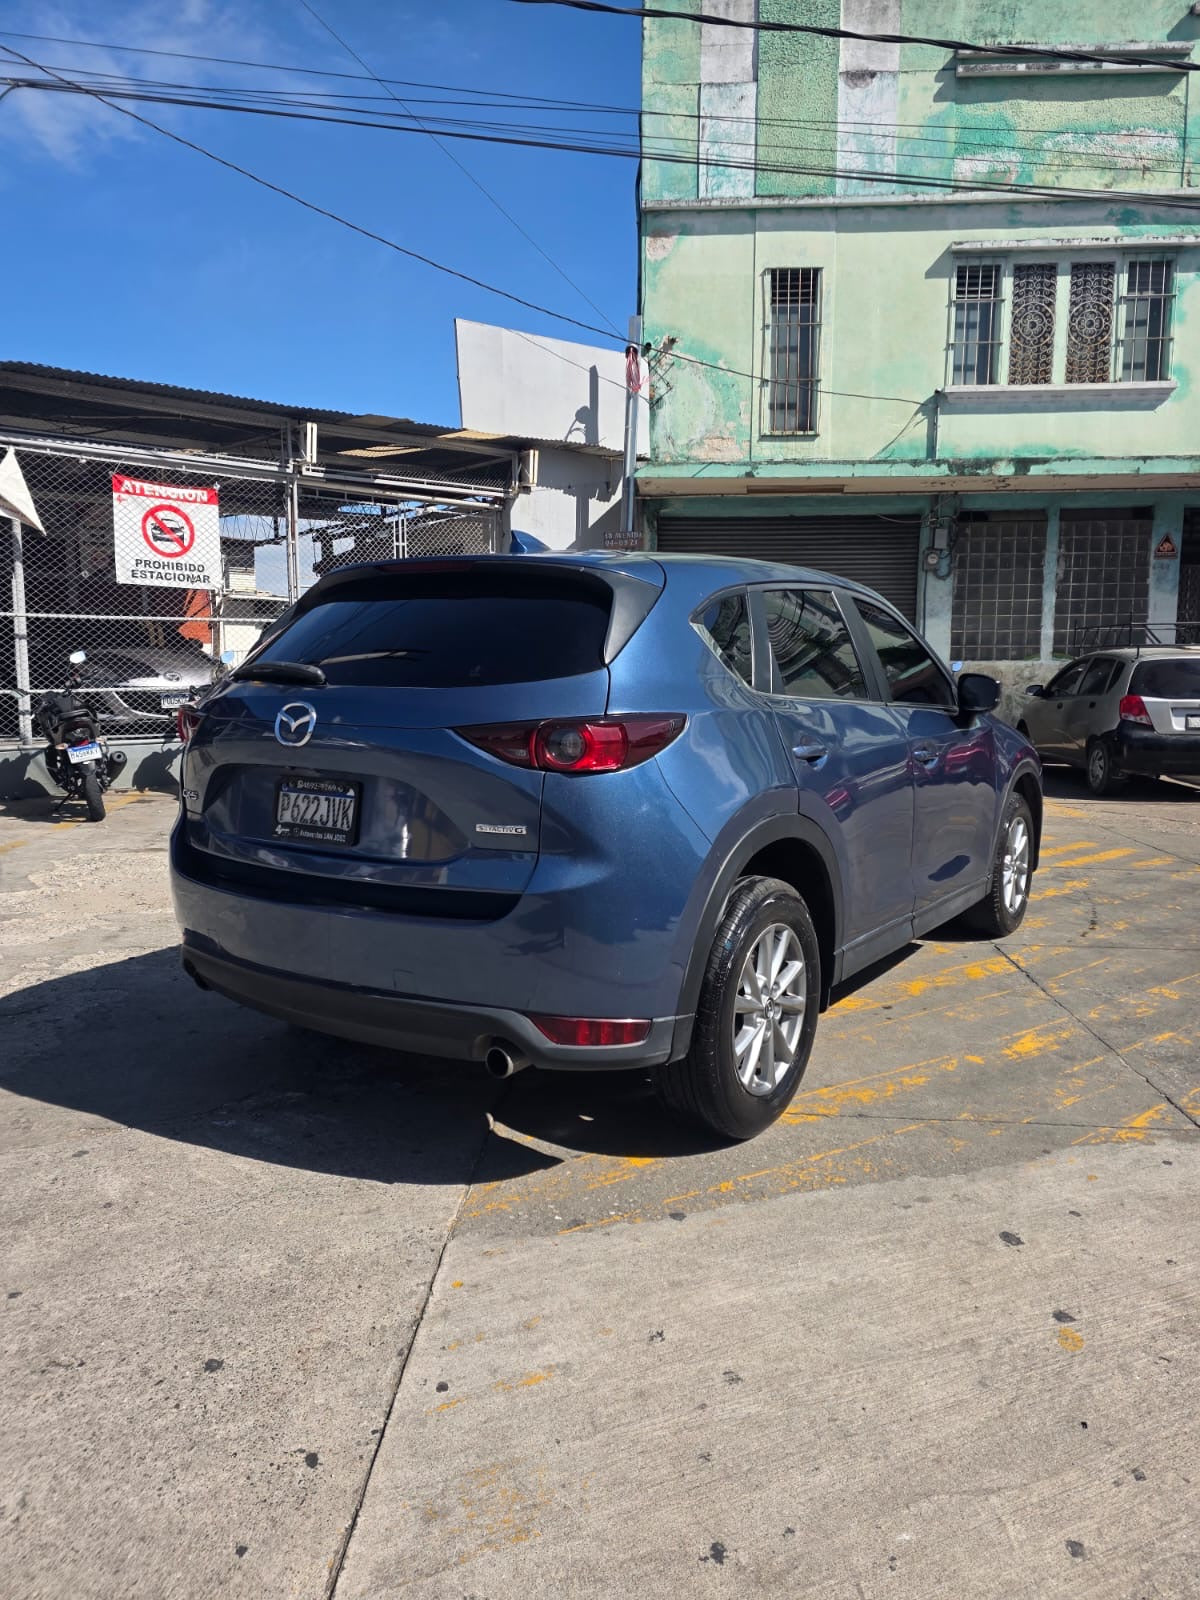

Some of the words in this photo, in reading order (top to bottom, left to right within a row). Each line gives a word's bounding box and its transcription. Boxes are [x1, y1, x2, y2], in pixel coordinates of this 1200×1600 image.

[135, 558, 205, 573] PROHIBIDO
[131, 569, 210, 584] ESTACIONAR
[280, 792, 353, 829] P622JVK
